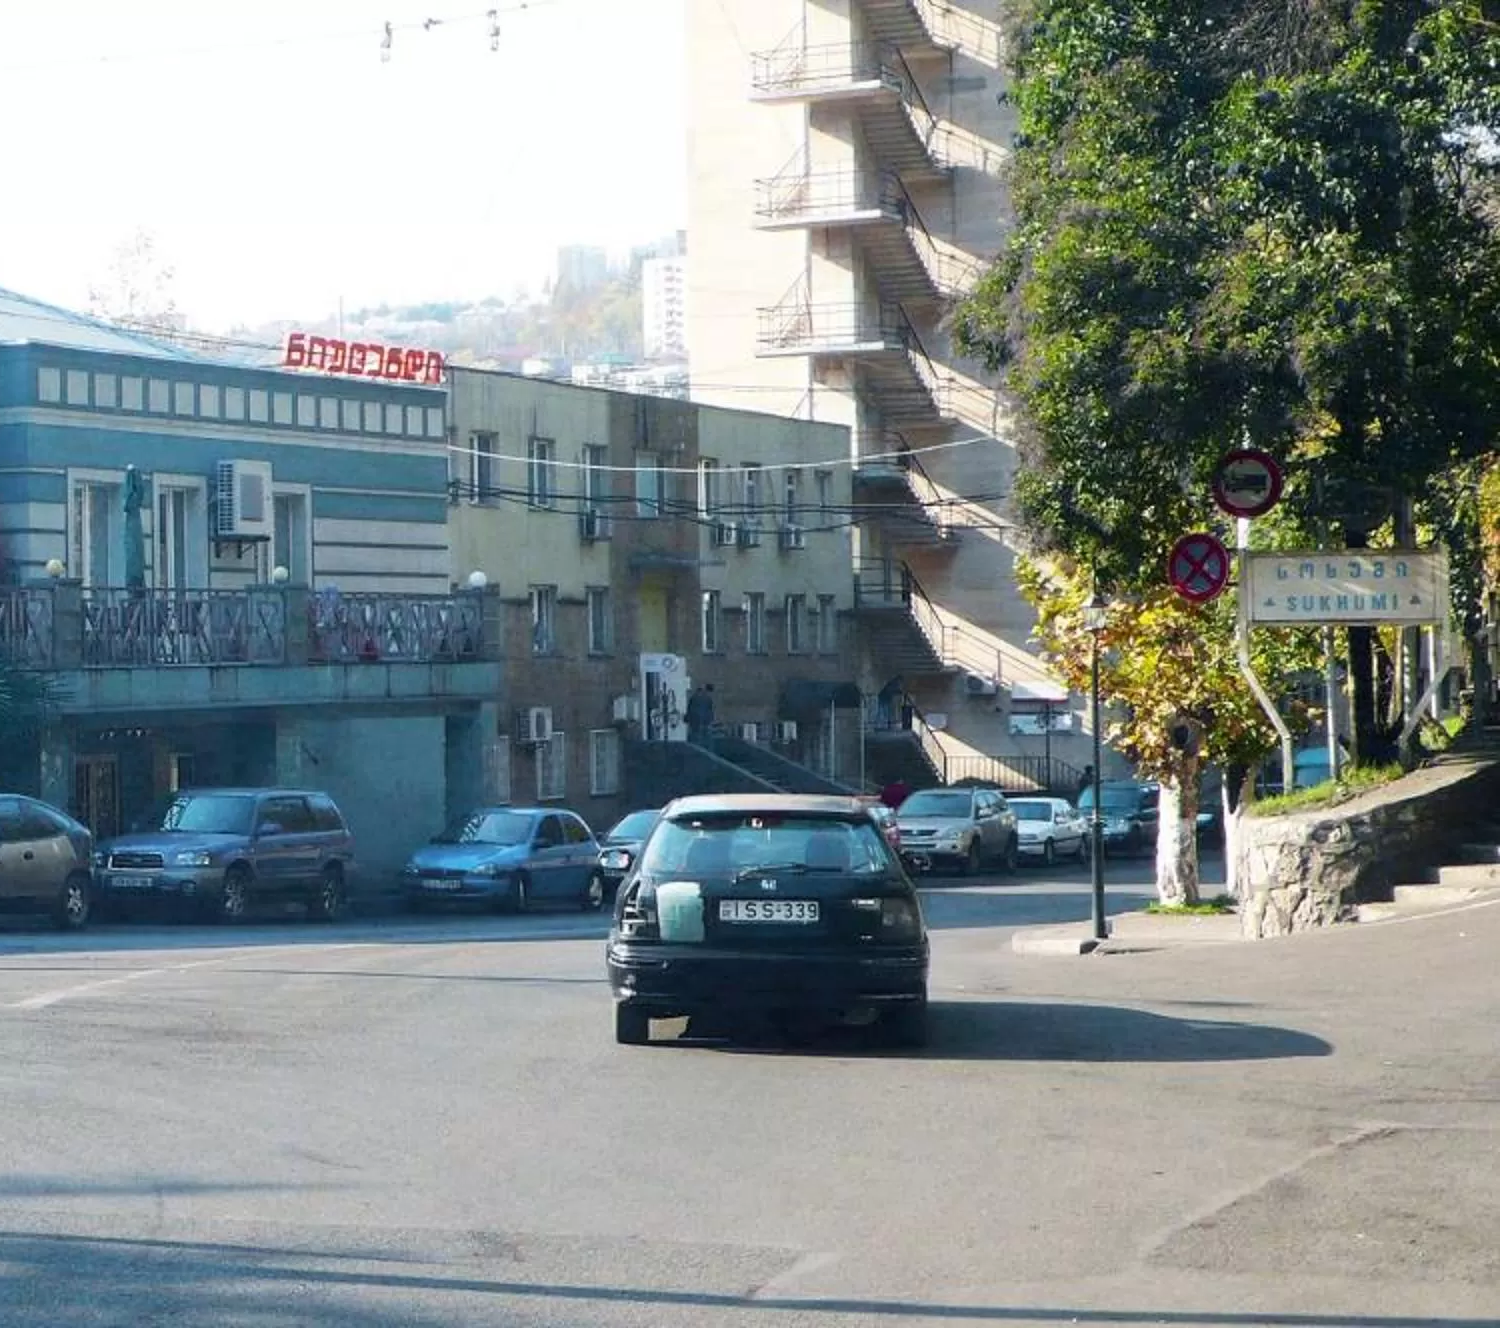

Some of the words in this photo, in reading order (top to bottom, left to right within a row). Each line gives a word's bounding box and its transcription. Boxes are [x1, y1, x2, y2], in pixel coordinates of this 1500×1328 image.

[1277, 561, 1409, 580] სოხუმი
[1286, 594, 1399, 612] SUKHUMI
[735, 901, 817, 919] ISS-339
